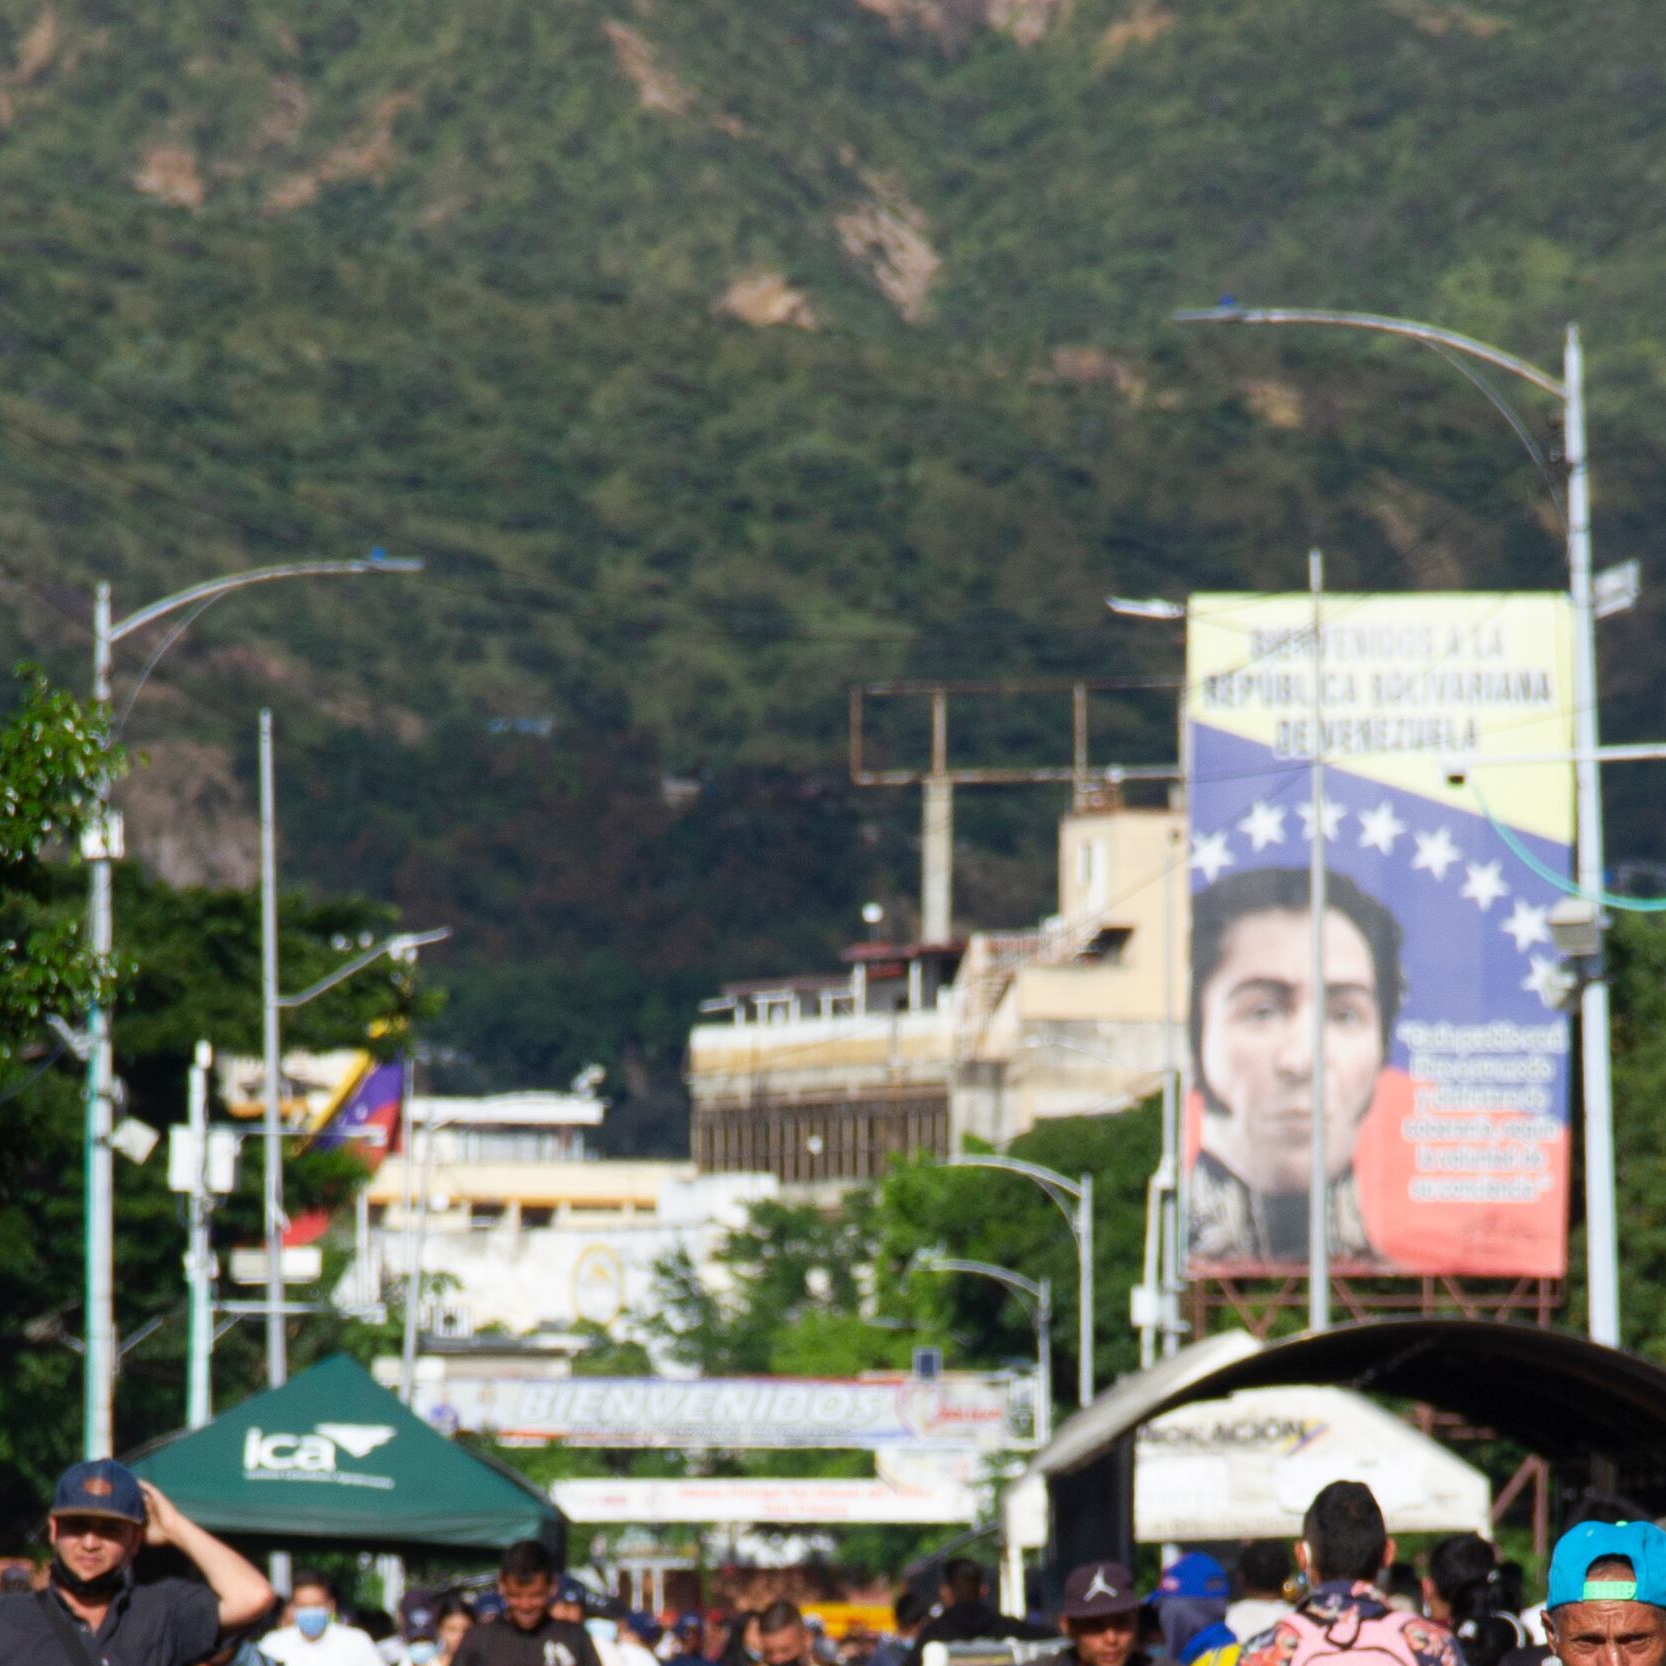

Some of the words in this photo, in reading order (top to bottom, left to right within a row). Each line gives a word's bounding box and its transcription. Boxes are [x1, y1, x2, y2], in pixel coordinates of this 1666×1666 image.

[1275, 717, 1307, 755] DE
[1320, 717, 1479, 754] VENEZUELA
[519, 1385, 882, 1425] BIENVENIDOS
